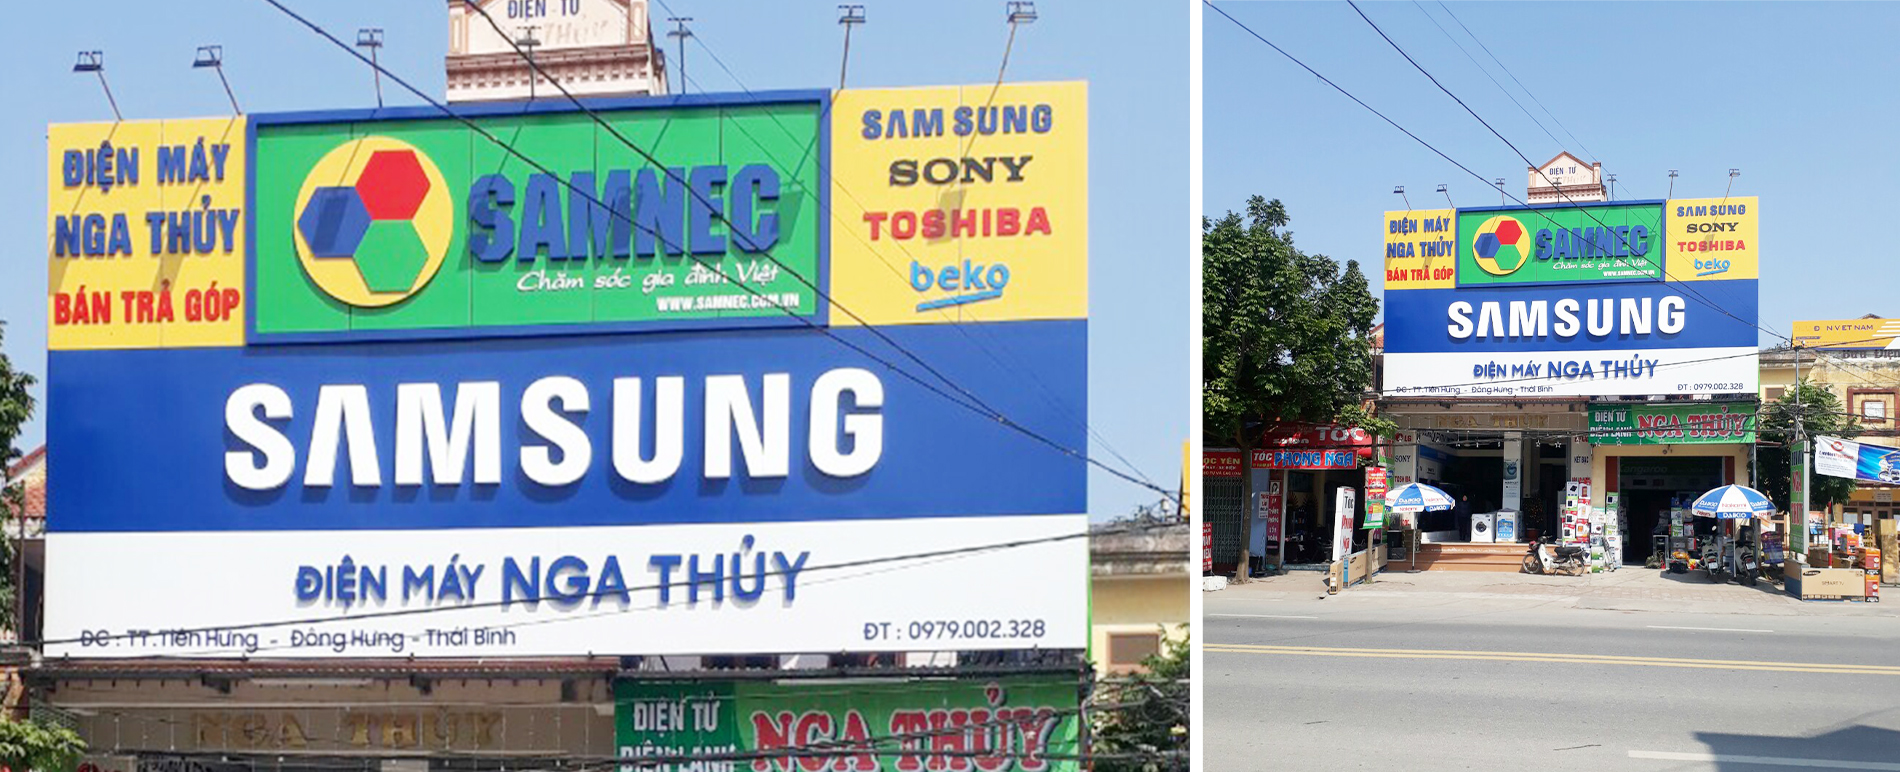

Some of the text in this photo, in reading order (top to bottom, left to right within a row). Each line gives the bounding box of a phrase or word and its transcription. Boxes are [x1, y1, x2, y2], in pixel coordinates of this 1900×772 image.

[63, 136, 230, 193] ĐIỆN MÁY
[888, 155, 1033, 187] SONY
[1549, 166, 1564, 176] ĐIỆN
[467, 163, 782, 262] SAMNEC
[863, 206, 1052, 241] TOSHIBA
[1389, 215, 1450, 236] ĐIỆN MÁY
[54, 195, 241, 258] NGA THỦY
[1686, 221, 1739, 234] SONY
[1386, 235, 1454, 258] NGA THỦY
[1535, 225, 1649, 260] SAMNEC
[1677, 240, 1746, 252] TOSHIBA
[516, 268, 585, 292] Chăm
[593, 268, 631, 289] sóc
[641, 270, 675, 293] gia
[735, 261, 779, 286] Việt
[909, 260, 1010, 292] beko
[1386, 264, 1454, 282] BÁN TRẢ GÓP
[1598, 262, 1611, 271] gia
[1693, 257, 1731, 271] beko
[54, 278, 241, 325] BÁN TRẢ GÓP
[656, 293, 800, 312] WWW.SAMNEC.COM.VN
[1446, 295, 1686, 339] SAMSUNG
[1473, 353, 1659, 379] ĐIỆN MÁY NGA THỦY
[1677, 383, 1688, 391] ĐT
[1694, 382, 1744, 391] 0979.002.328
[223, 366, 885, 491] SAMSUNG
[1594, 410, 1613, 424] ĐIỆN
[1637, 404, 1749, 438] NGA THỦY
[1254, 451, 1272, 461] TÓC
[1324, 451, 1354, 467] NGA
[1395, 455, 1411, 463] SONY
[295, 534, 812, 612] ĐIỆN MÁY NGA THỦY
[205, 630, 258, 653] Hưng
[290, 627, 346, 653] Đông
[351, 630, 404, 652] Hưng
[425, 627, 468, 646] Thái
[473, 626, 516, 646] Bình
[863, 622, 892, 641] ĐT
[908, 619, 1047, 641] 0979.002.328
[633, 695, 685, 738] ĐIỆN
[750, 710, 873, 772] NGA
